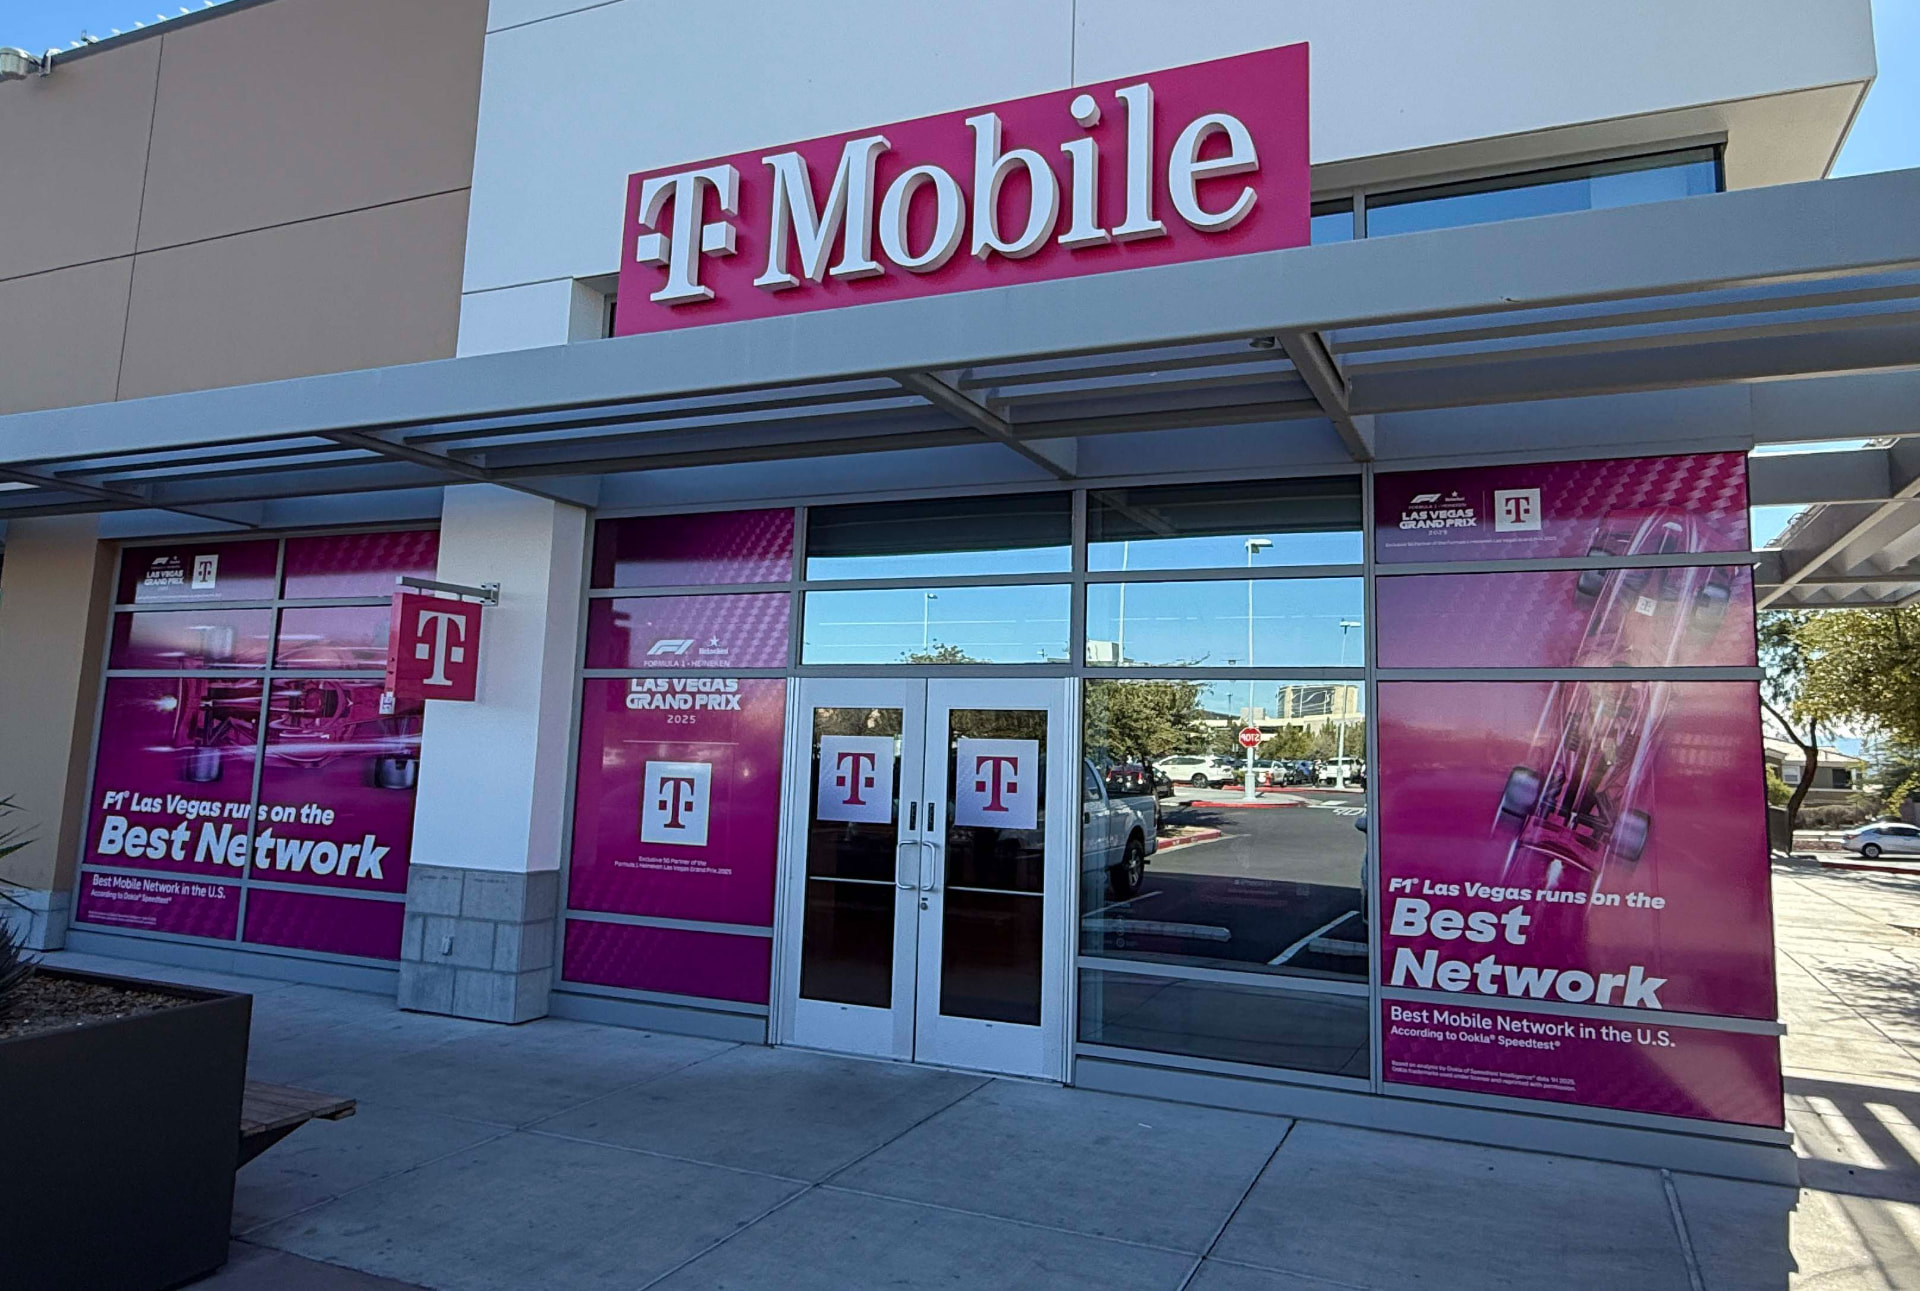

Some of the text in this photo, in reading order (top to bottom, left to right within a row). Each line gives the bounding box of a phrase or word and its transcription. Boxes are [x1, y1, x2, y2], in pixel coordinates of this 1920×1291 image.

[637, 83, 1259, 305] T Mobile
[1399, 517, 1477, 529] GRAND PRIX
[1402, 508, 1474, 521] LAS VEGAS
[415, 609, 467, 686] T
[626, 693, 742, 711] GRAND PRIX
[631, 678, 739, 693] LAS VEGAS
[666, 714, 697, 724] 2025
[836, 752, 876, 806] T
[974, 756, 1019, 812] T
[130, 792, 163, 814] Las
[166, 794, 222, 820] Vegas
[270, 805, 297, 823] on
[300, 803, 335, 826] the
[658, 777, 695, 829] T
[97, 815, 391, 880] Best Network
[92, 874, 227, 900] Best Mobile Network in the U.S.
[1423, 880, 1460, 897] Las
[1465, 882, 1532, 902] Vegas
[1536, 889, 1587, 904] runs
[1591, 892, 1620, 906] on
[1625, 892, 1666, 909] the
[1389, 897, 1531, 945] Best
[1390, 947, 1668, 1009] Network
[1390, 1005, 1676, 1048] Best Mobile Network in the U.S.
[1390, 1025, 1443, 1041] According
[1445, 1030, 1457, 1040] to
